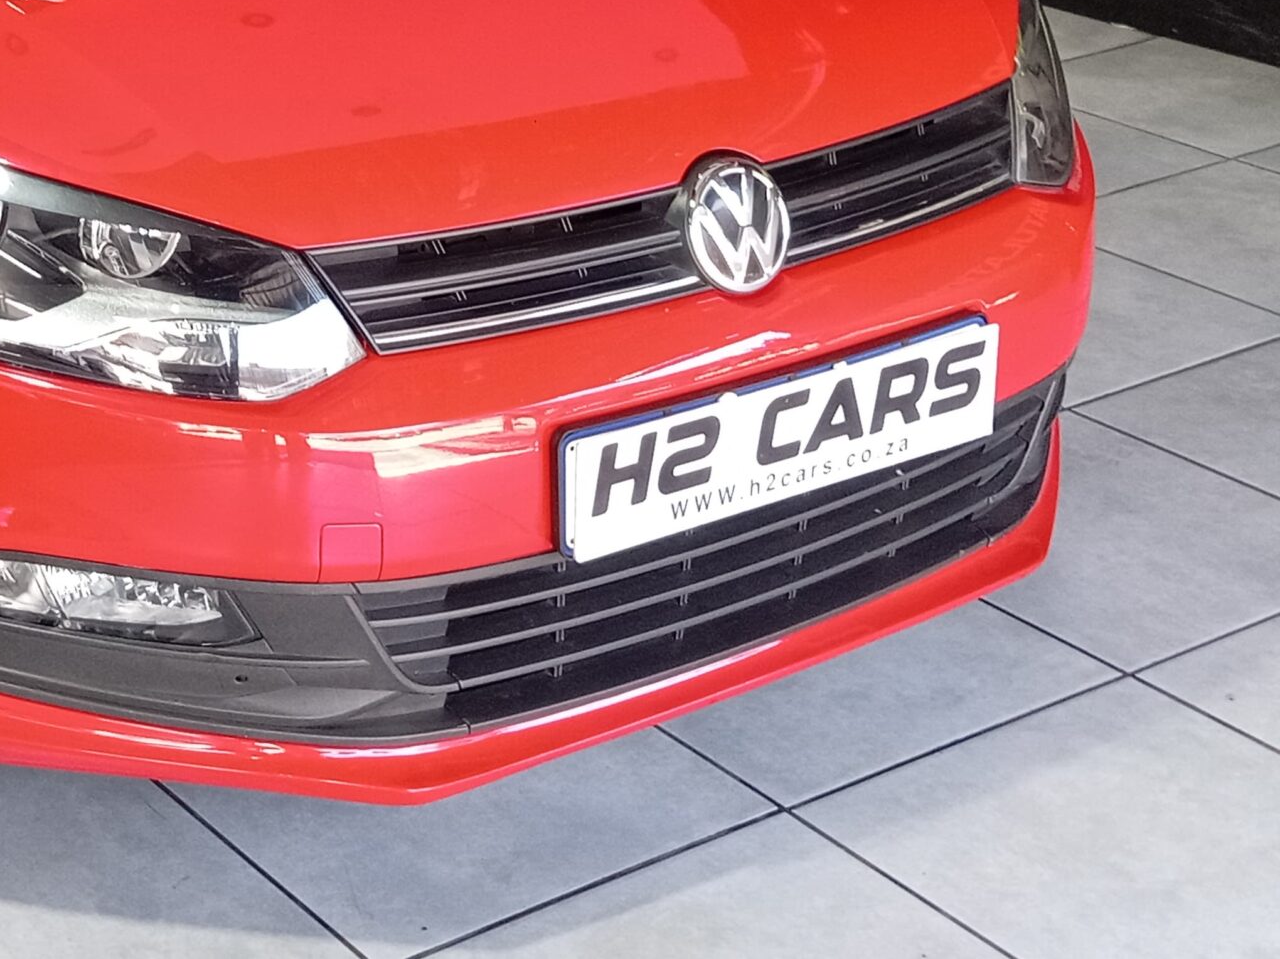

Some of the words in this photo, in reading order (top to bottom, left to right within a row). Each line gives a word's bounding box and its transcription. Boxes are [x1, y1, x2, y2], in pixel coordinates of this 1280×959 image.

[591, 415, 721, 518] H2
[755, 340, 986, 467] CARS
[670, 437, 909, 520] www.h2cars.co.za
